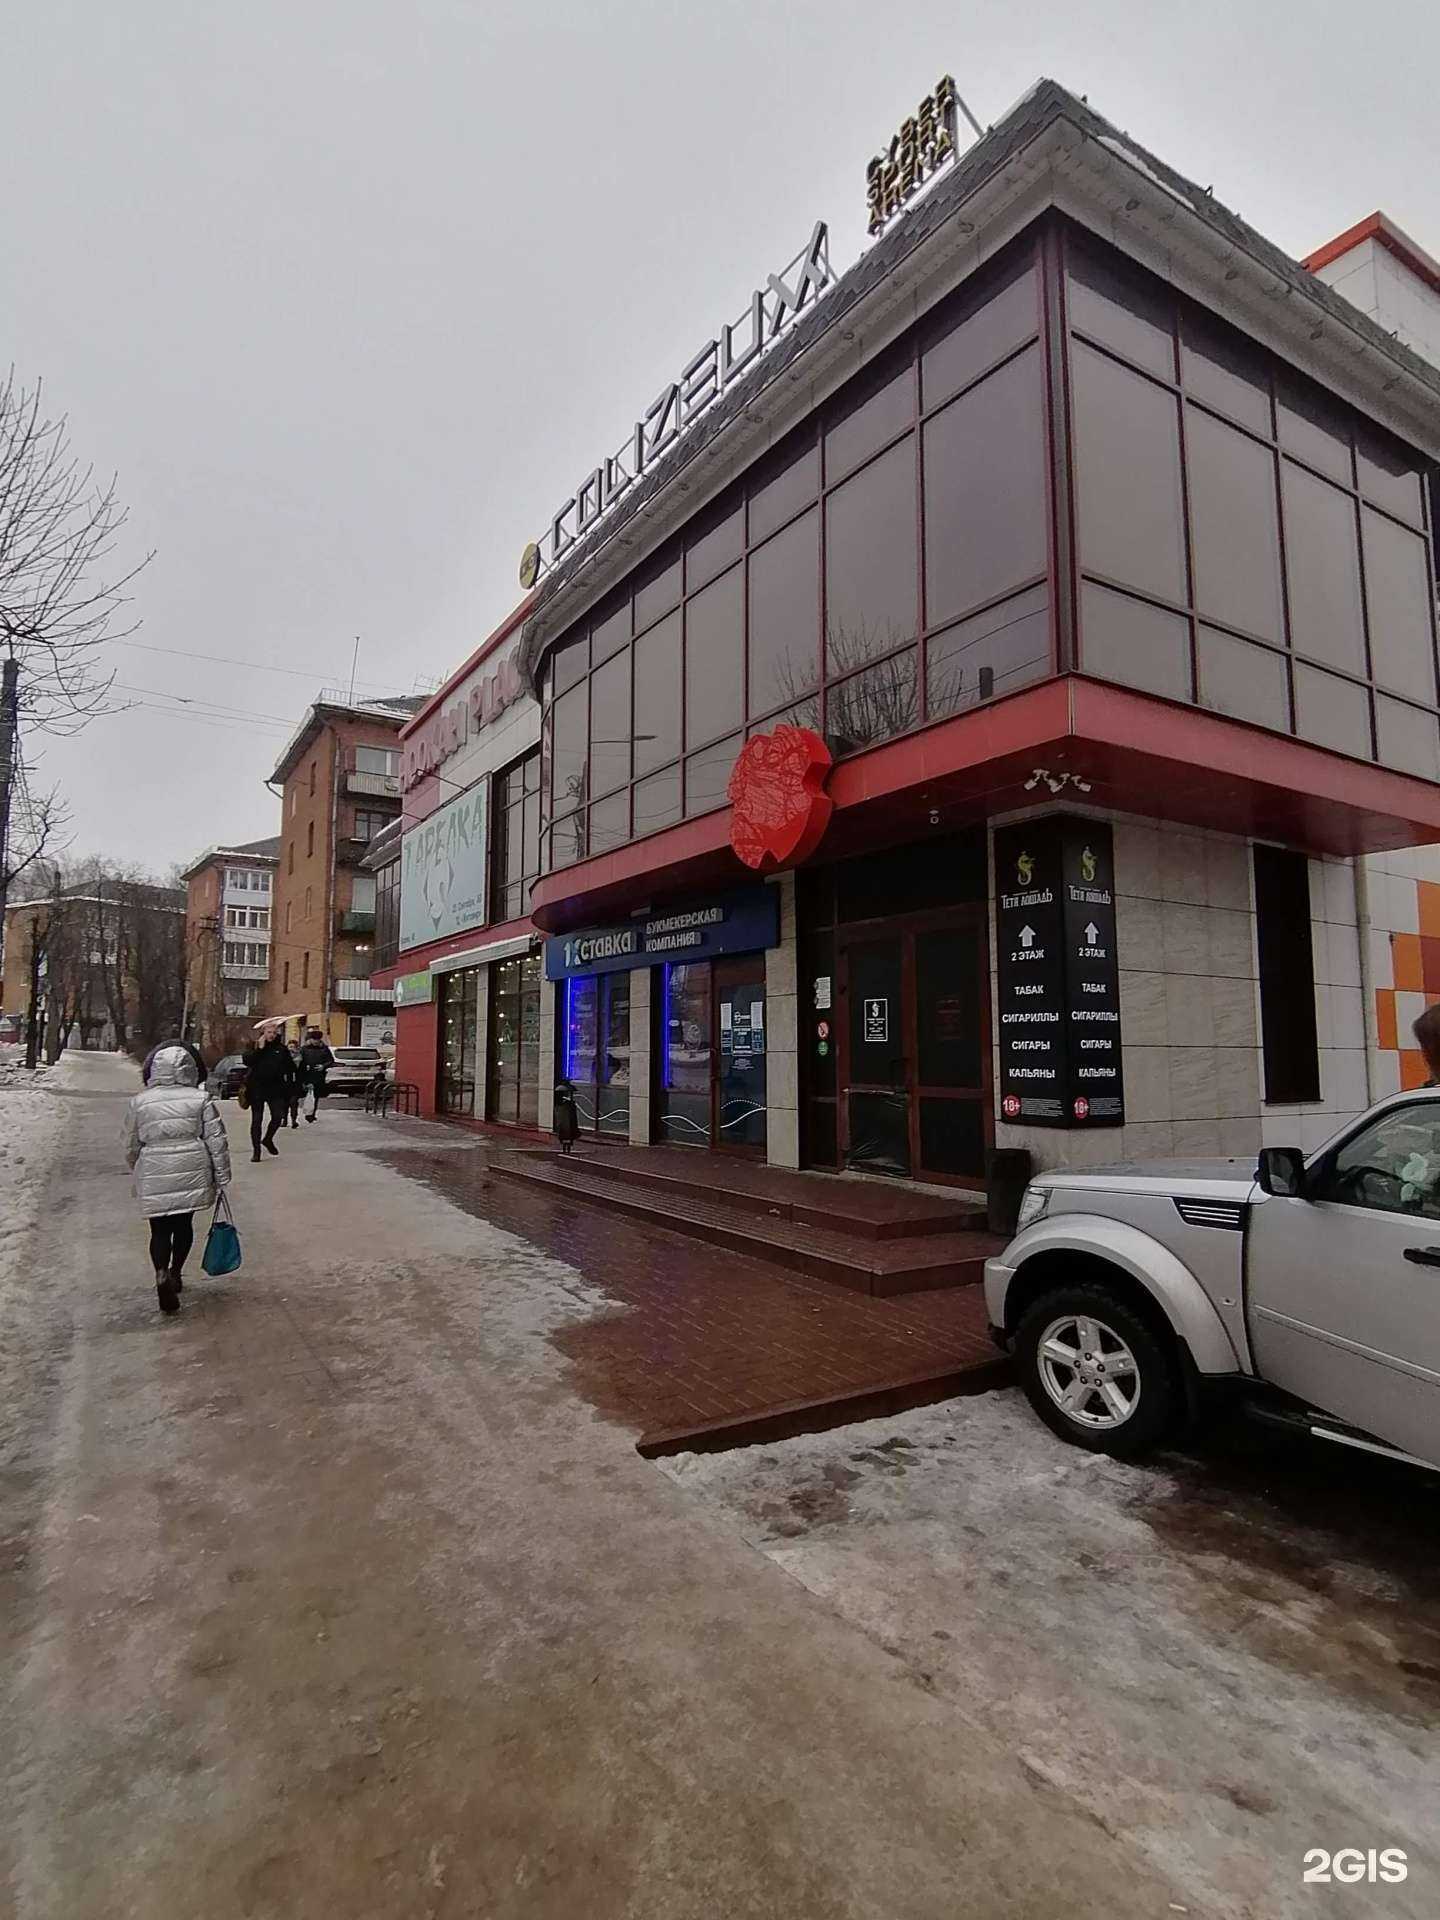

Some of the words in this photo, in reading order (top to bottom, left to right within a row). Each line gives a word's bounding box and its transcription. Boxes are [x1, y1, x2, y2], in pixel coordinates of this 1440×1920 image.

[551, 220, 828, 561] COLIZEUM
[646, 908, 719, 934] БУКМЕКЕРСКАЯ
[646, 932, 696, 952] КОМПАНИЯ
[1011, 952, 1017, 961] 2
[1018, 949, 1045, 960] ЭТАЖ
[1078, 947, 1084, 957] 2
[1085, 948, 1106, 958] ЭТАЖ
[1014, 985, 1044, 995] ТАБАК
[1082, 983, 1106, 993] ТАБАК
[1002, 1012, 1059, 1023] СИГАРИЛЛЫ
[1071, 1011, 1118, 1021] СИГАРИЛЛЫ
[1012, 1041, 1051, 1050] СИГАРЫ
[1080, 1040, 1112, 1049] СИГАРЫ
[1009, 1068, 1055, 1078] КАЛЬЯНЫ
[1078, 1067, 1116, 1077] КАЛЬЯНЫ
[1002, 1099, 1020, 1112] 18+
[1074, 1101, 1089, 1114] 18+
